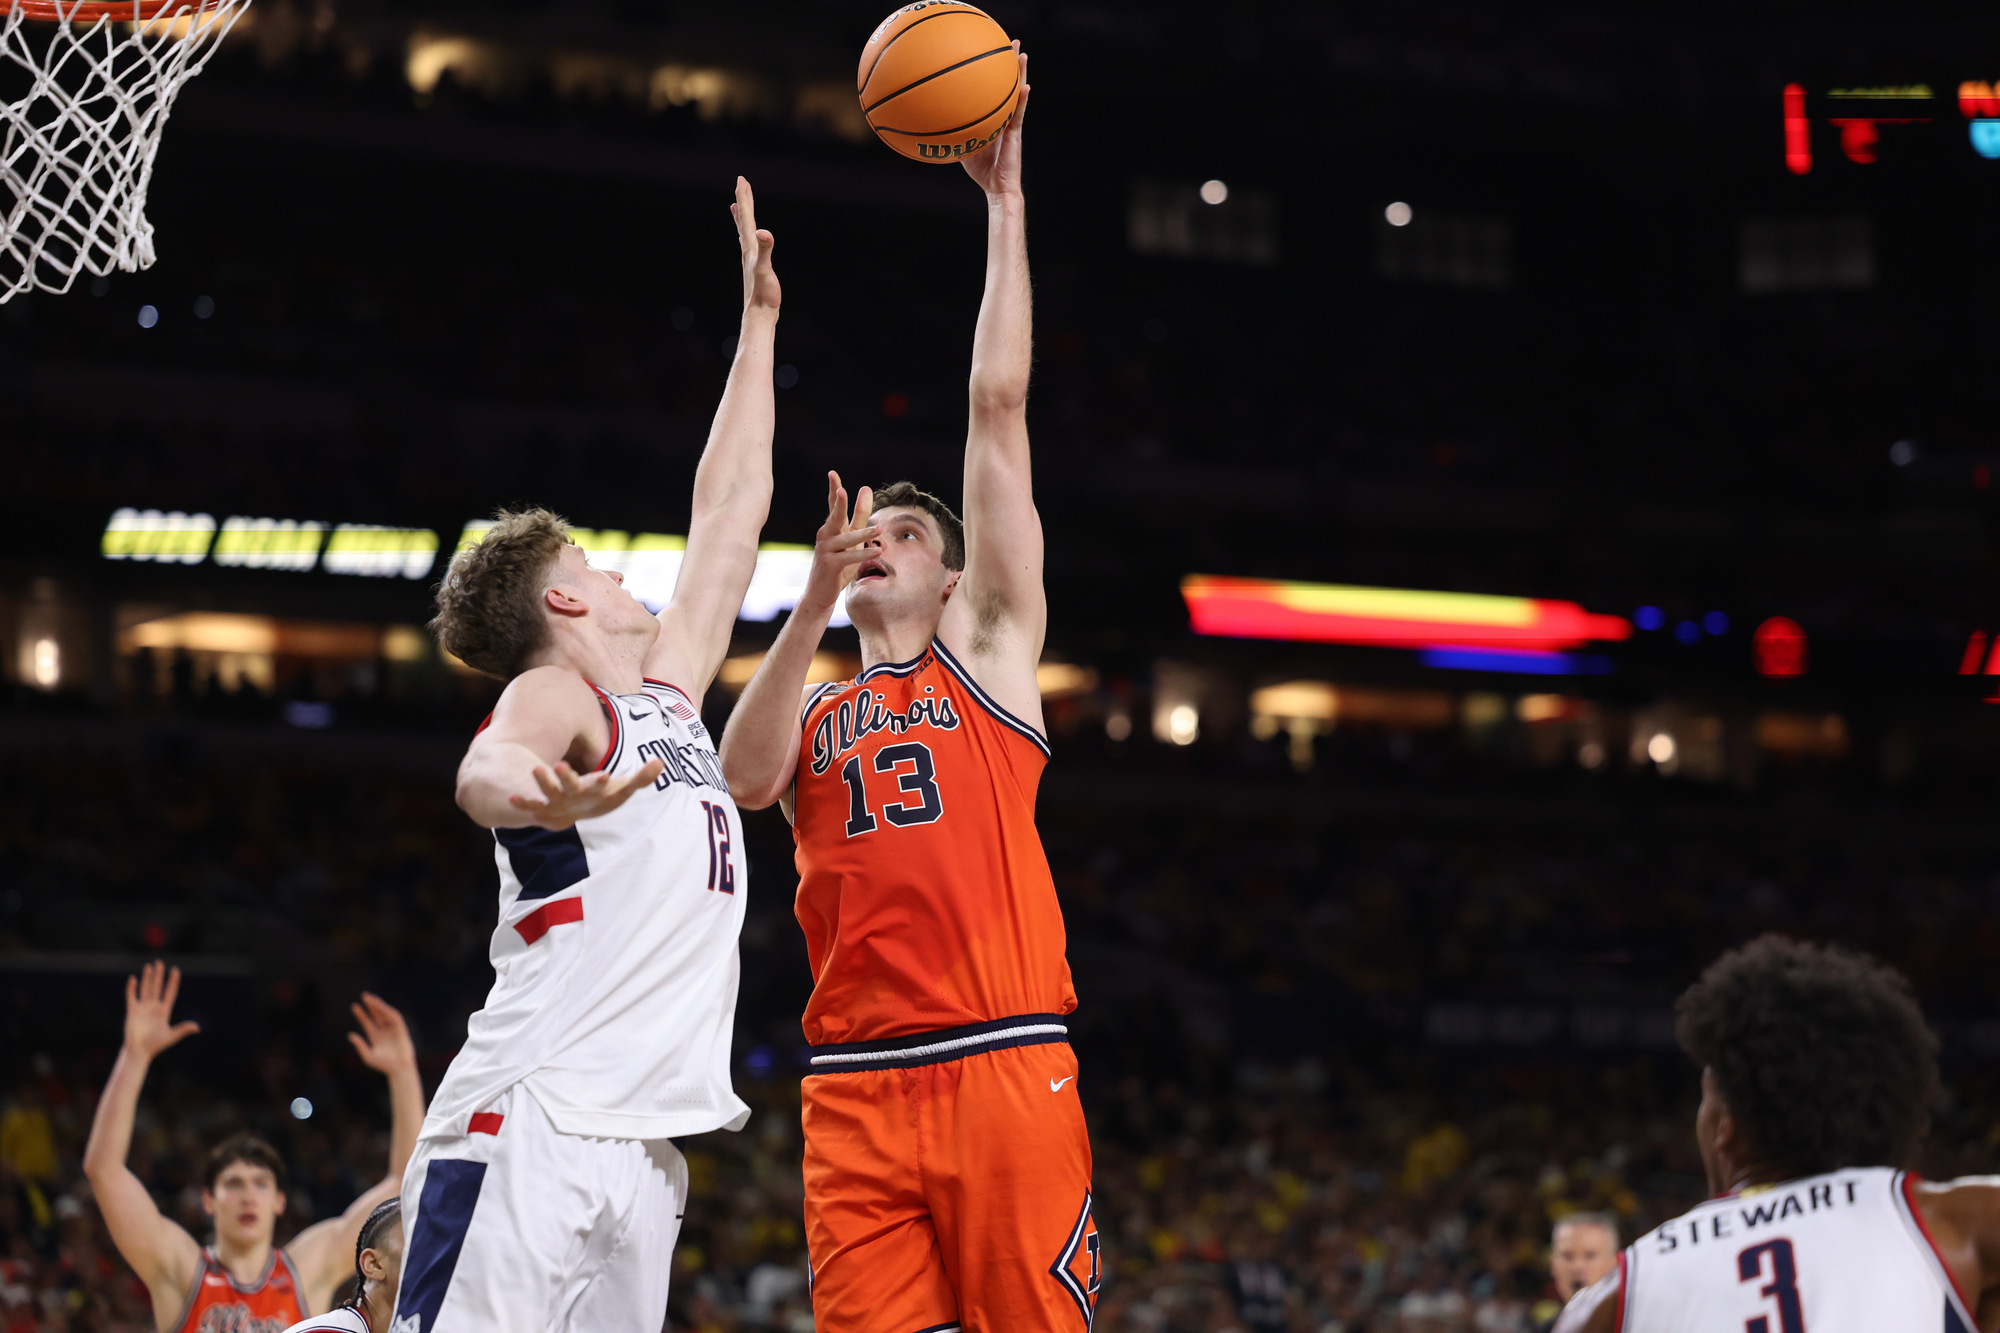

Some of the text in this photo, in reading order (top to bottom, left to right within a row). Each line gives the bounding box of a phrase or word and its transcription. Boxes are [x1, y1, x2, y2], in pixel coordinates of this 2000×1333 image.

[810, 685, 960, 776] Illinois
[841, 741, 944, 838] 13
[700, 800, 735, 896] 12
[1658, 1180, 1860, 1254] STEWART
[1737, 1237, 1805, 1333] 3
